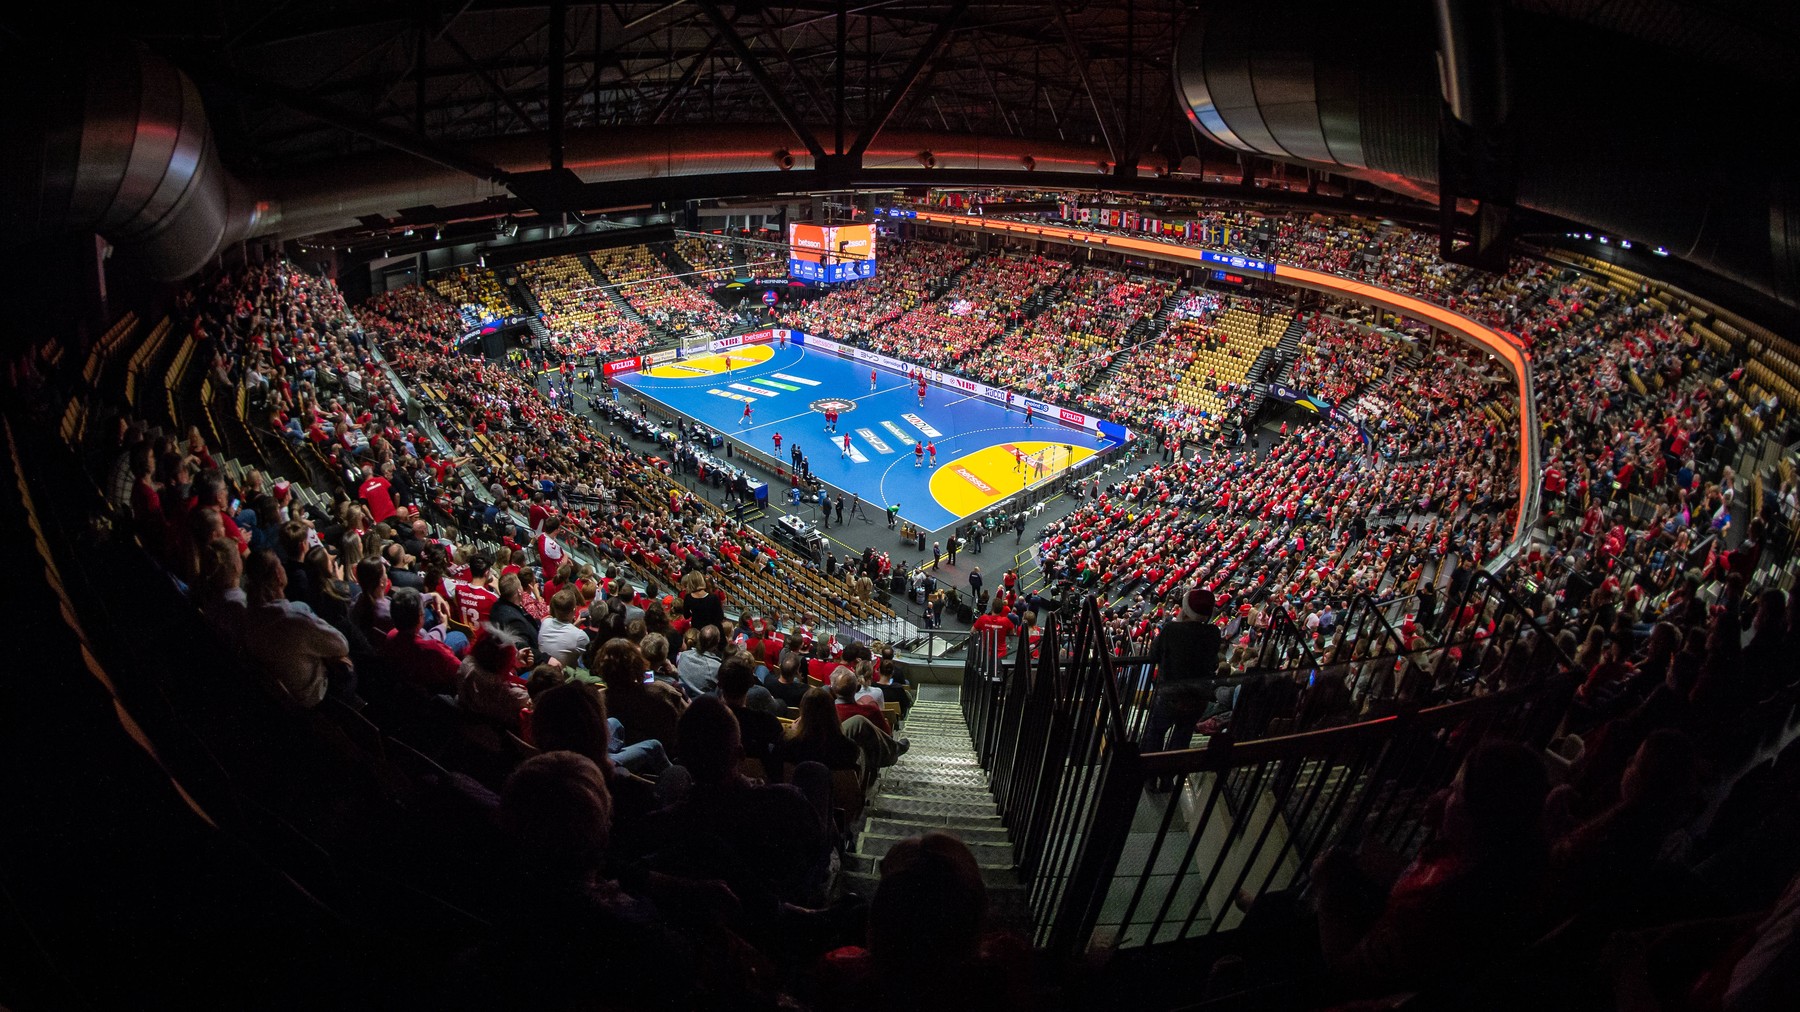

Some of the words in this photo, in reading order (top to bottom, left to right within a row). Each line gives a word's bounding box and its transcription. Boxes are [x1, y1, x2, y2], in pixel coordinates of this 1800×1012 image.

[798, 238, 820, 248] betsson
[745, 331, 771, 341] betsson
[860, 351, 879, 362] BYD
[611, 360, 634, 370] VELUX
[956, 379, 977, 392] NIBE
[1062, 411, 1083, 422] VELUX
[859, 429, 889, 451] BYD
[957, 468, 992, 492] betsson
[461, 607, 480, 629] 13
